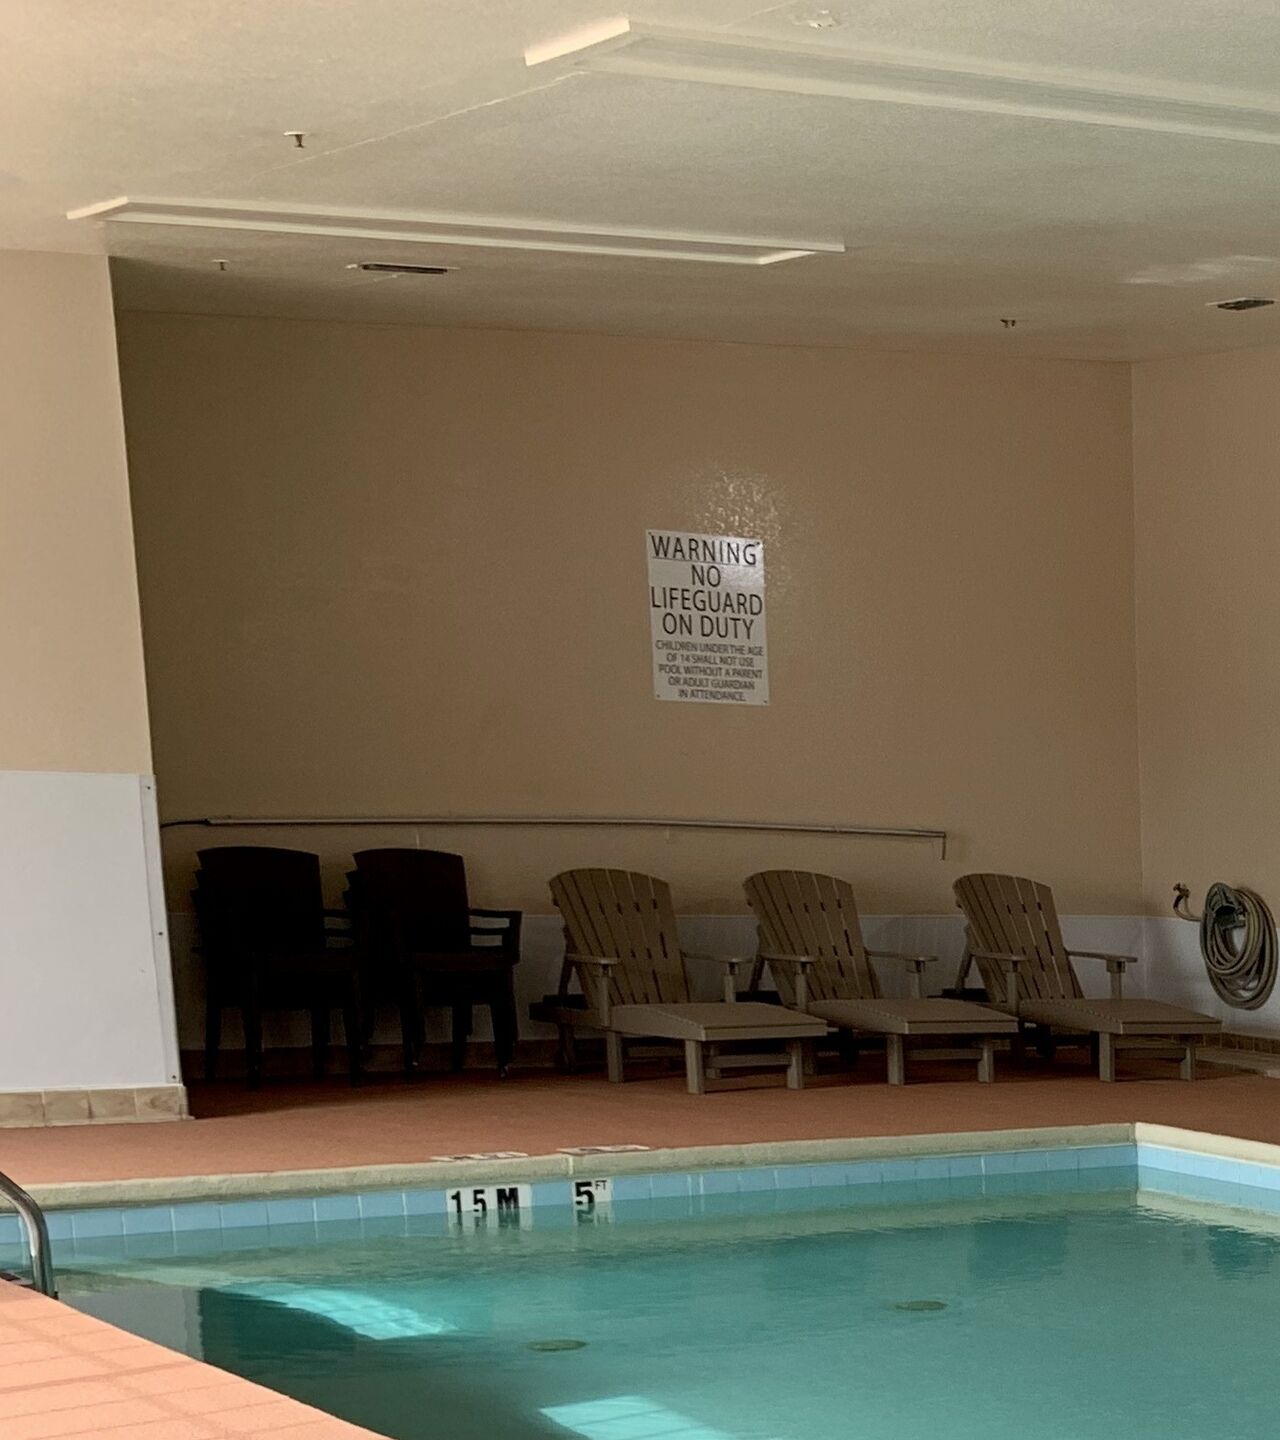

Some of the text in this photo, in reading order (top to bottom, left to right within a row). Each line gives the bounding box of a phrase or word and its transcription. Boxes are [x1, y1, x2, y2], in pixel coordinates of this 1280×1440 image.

[651, 535, 757, 565] WARNING
[691, 565, 721, 587] NO
[651, 586, 763, 616] LIFEGUARD
[662, 612, 755, 639] ON DUTY
[655, 639, 764, 656] CHILDREN UNDER THE AGE
[666, 652, 678, 663] OF
[691, 654, 718, 665] SHALL
[719, 656, 737, 666] NOT
[738, 657, 755, 668] USE
[658, 663, 763, 679] POOL WITHOUT A PARENT
[667, 676, 755, 690] OR ADULT GUARDIAN
[678, 688, 688, 698] IN
[575, 1179, 608, 1206] 5 FT
